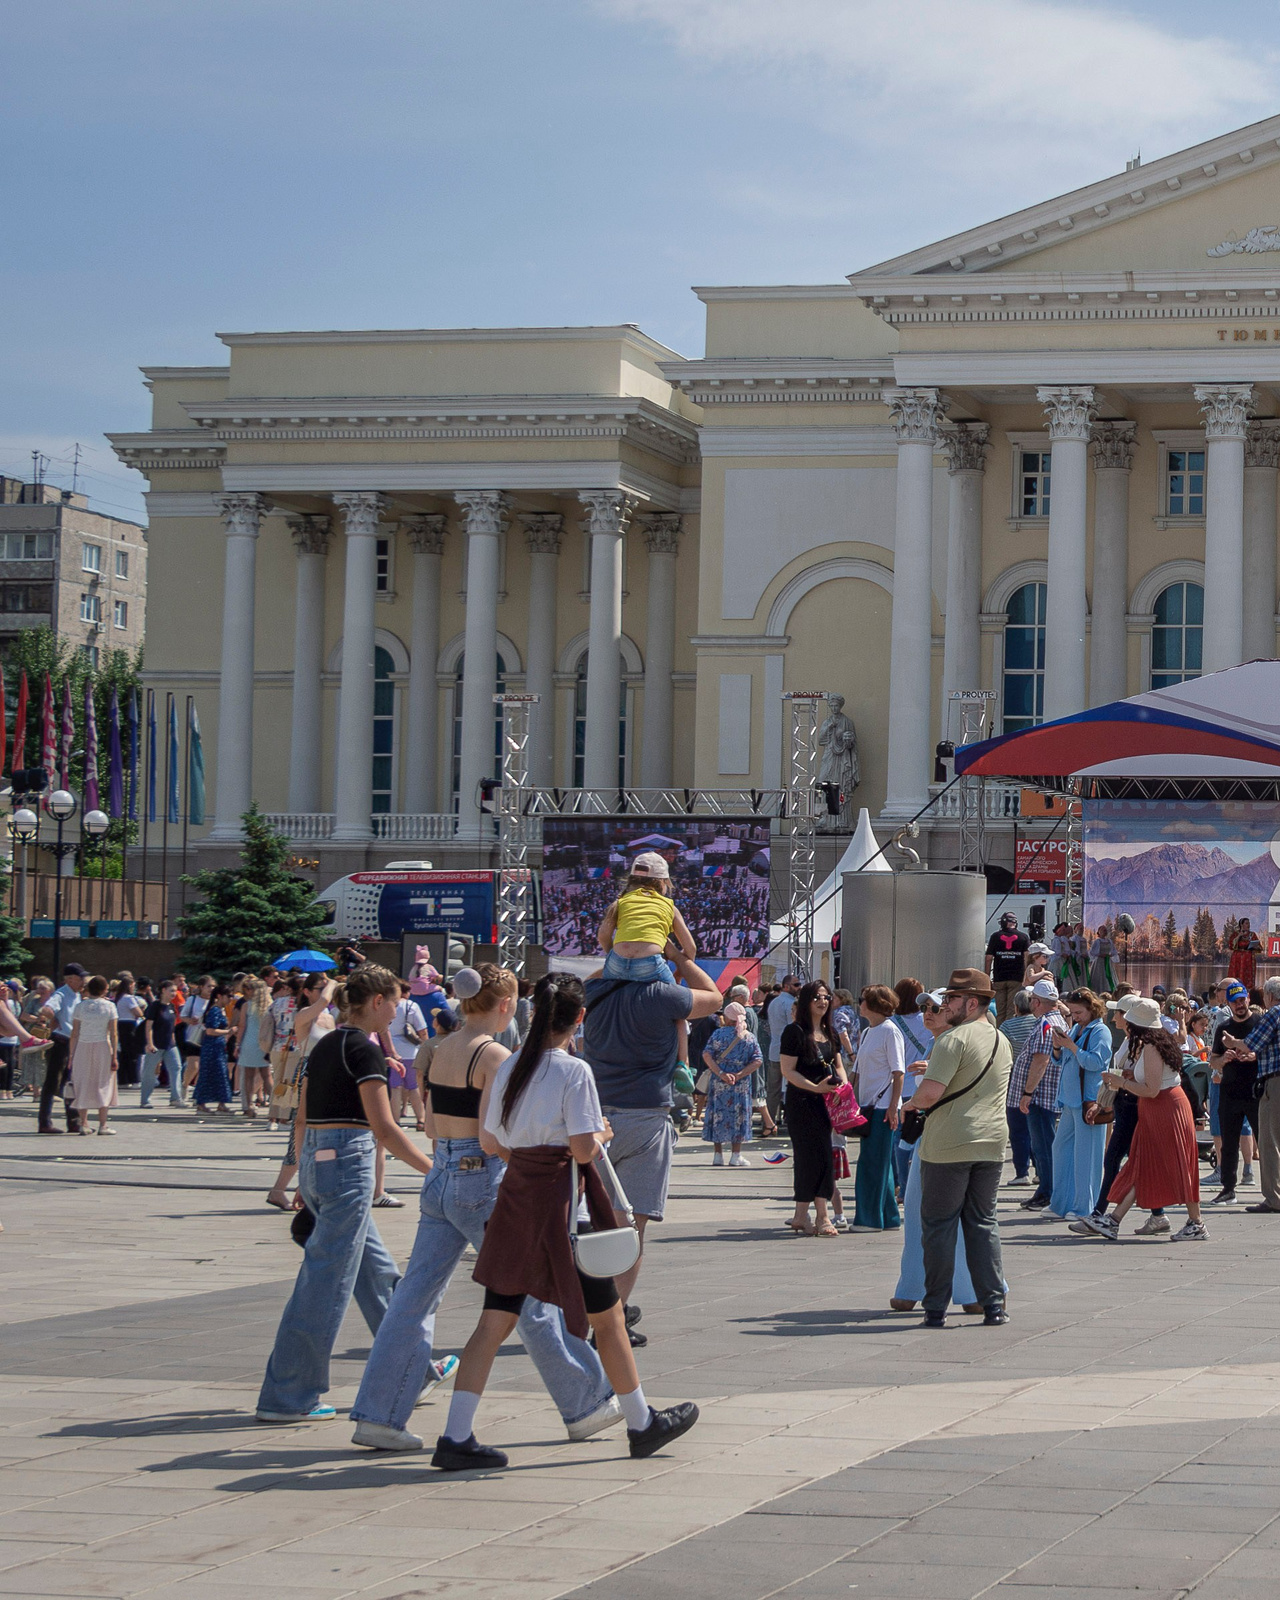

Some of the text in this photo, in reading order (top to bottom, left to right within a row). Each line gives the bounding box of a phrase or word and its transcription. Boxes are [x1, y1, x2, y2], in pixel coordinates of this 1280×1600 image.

[1017, 841, 1083, 853] ГАСТРО
[410, 873, 461, 881] ТЕЛЕВИЗИОННАЯ
[414, 922, 460, 930] tyumen-time.ru
